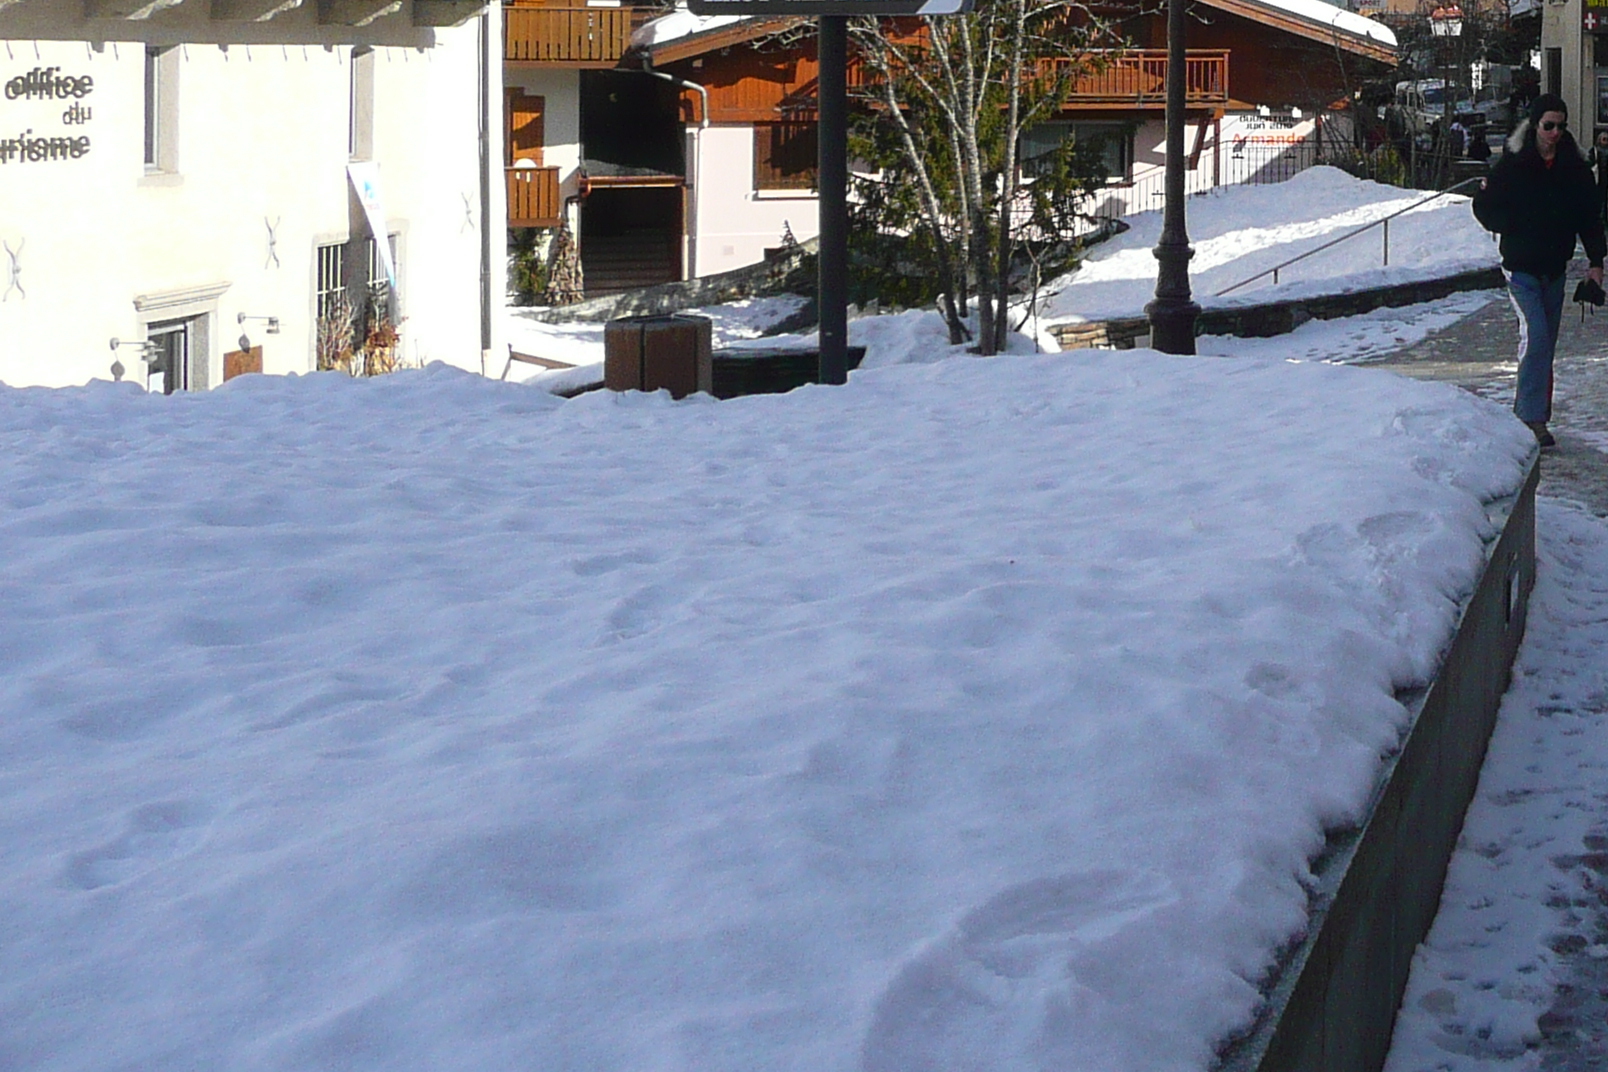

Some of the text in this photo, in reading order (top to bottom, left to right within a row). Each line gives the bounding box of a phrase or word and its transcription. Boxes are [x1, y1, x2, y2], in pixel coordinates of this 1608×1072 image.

[5, 66, 94, 100] office
[62, 101, 92, 125] du
[1232, 131, 1306, 145] Armando
